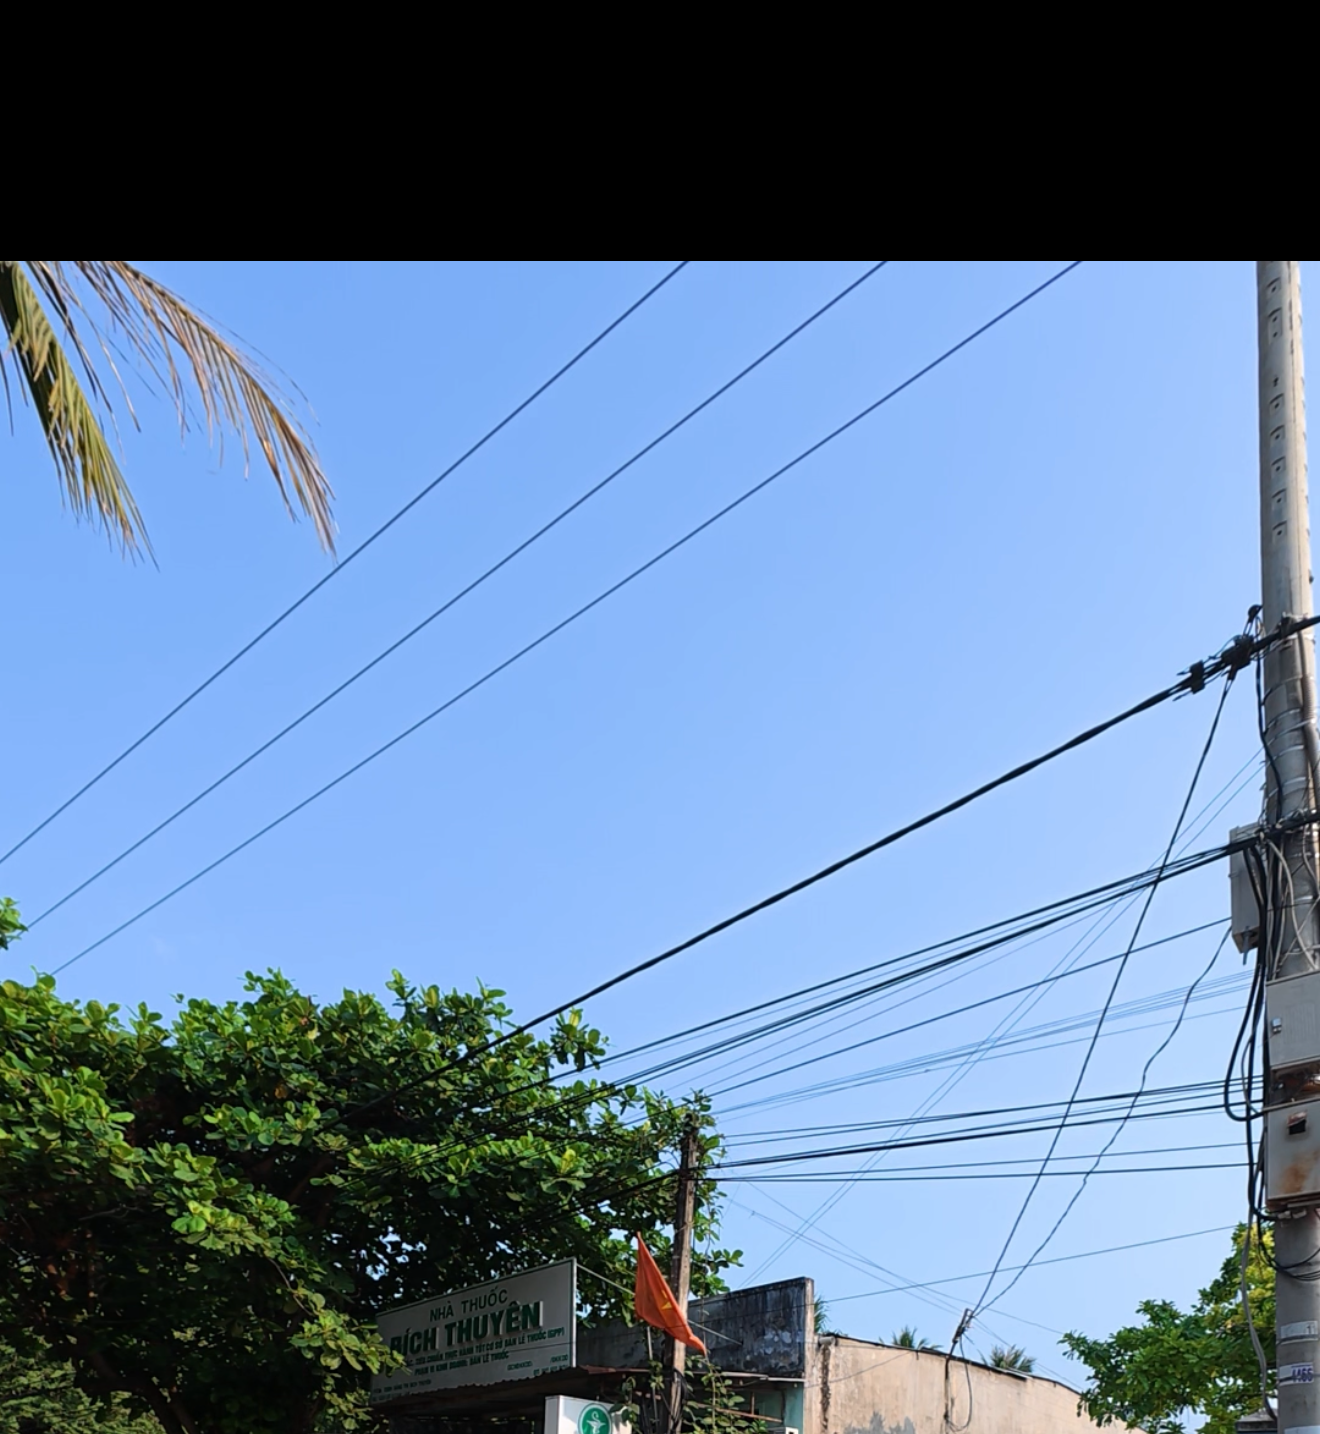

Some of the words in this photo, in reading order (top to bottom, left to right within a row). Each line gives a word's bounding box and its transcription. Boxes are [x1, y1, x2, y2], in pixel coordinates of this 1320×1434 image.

[429, 1300, 454, 1322] NHÀ
[461, 1286, 508, 1314] THUỐC
[390, 1327, 438, 1356] BÍCH
[445, 1300, 543, 1347] THUYÊN
